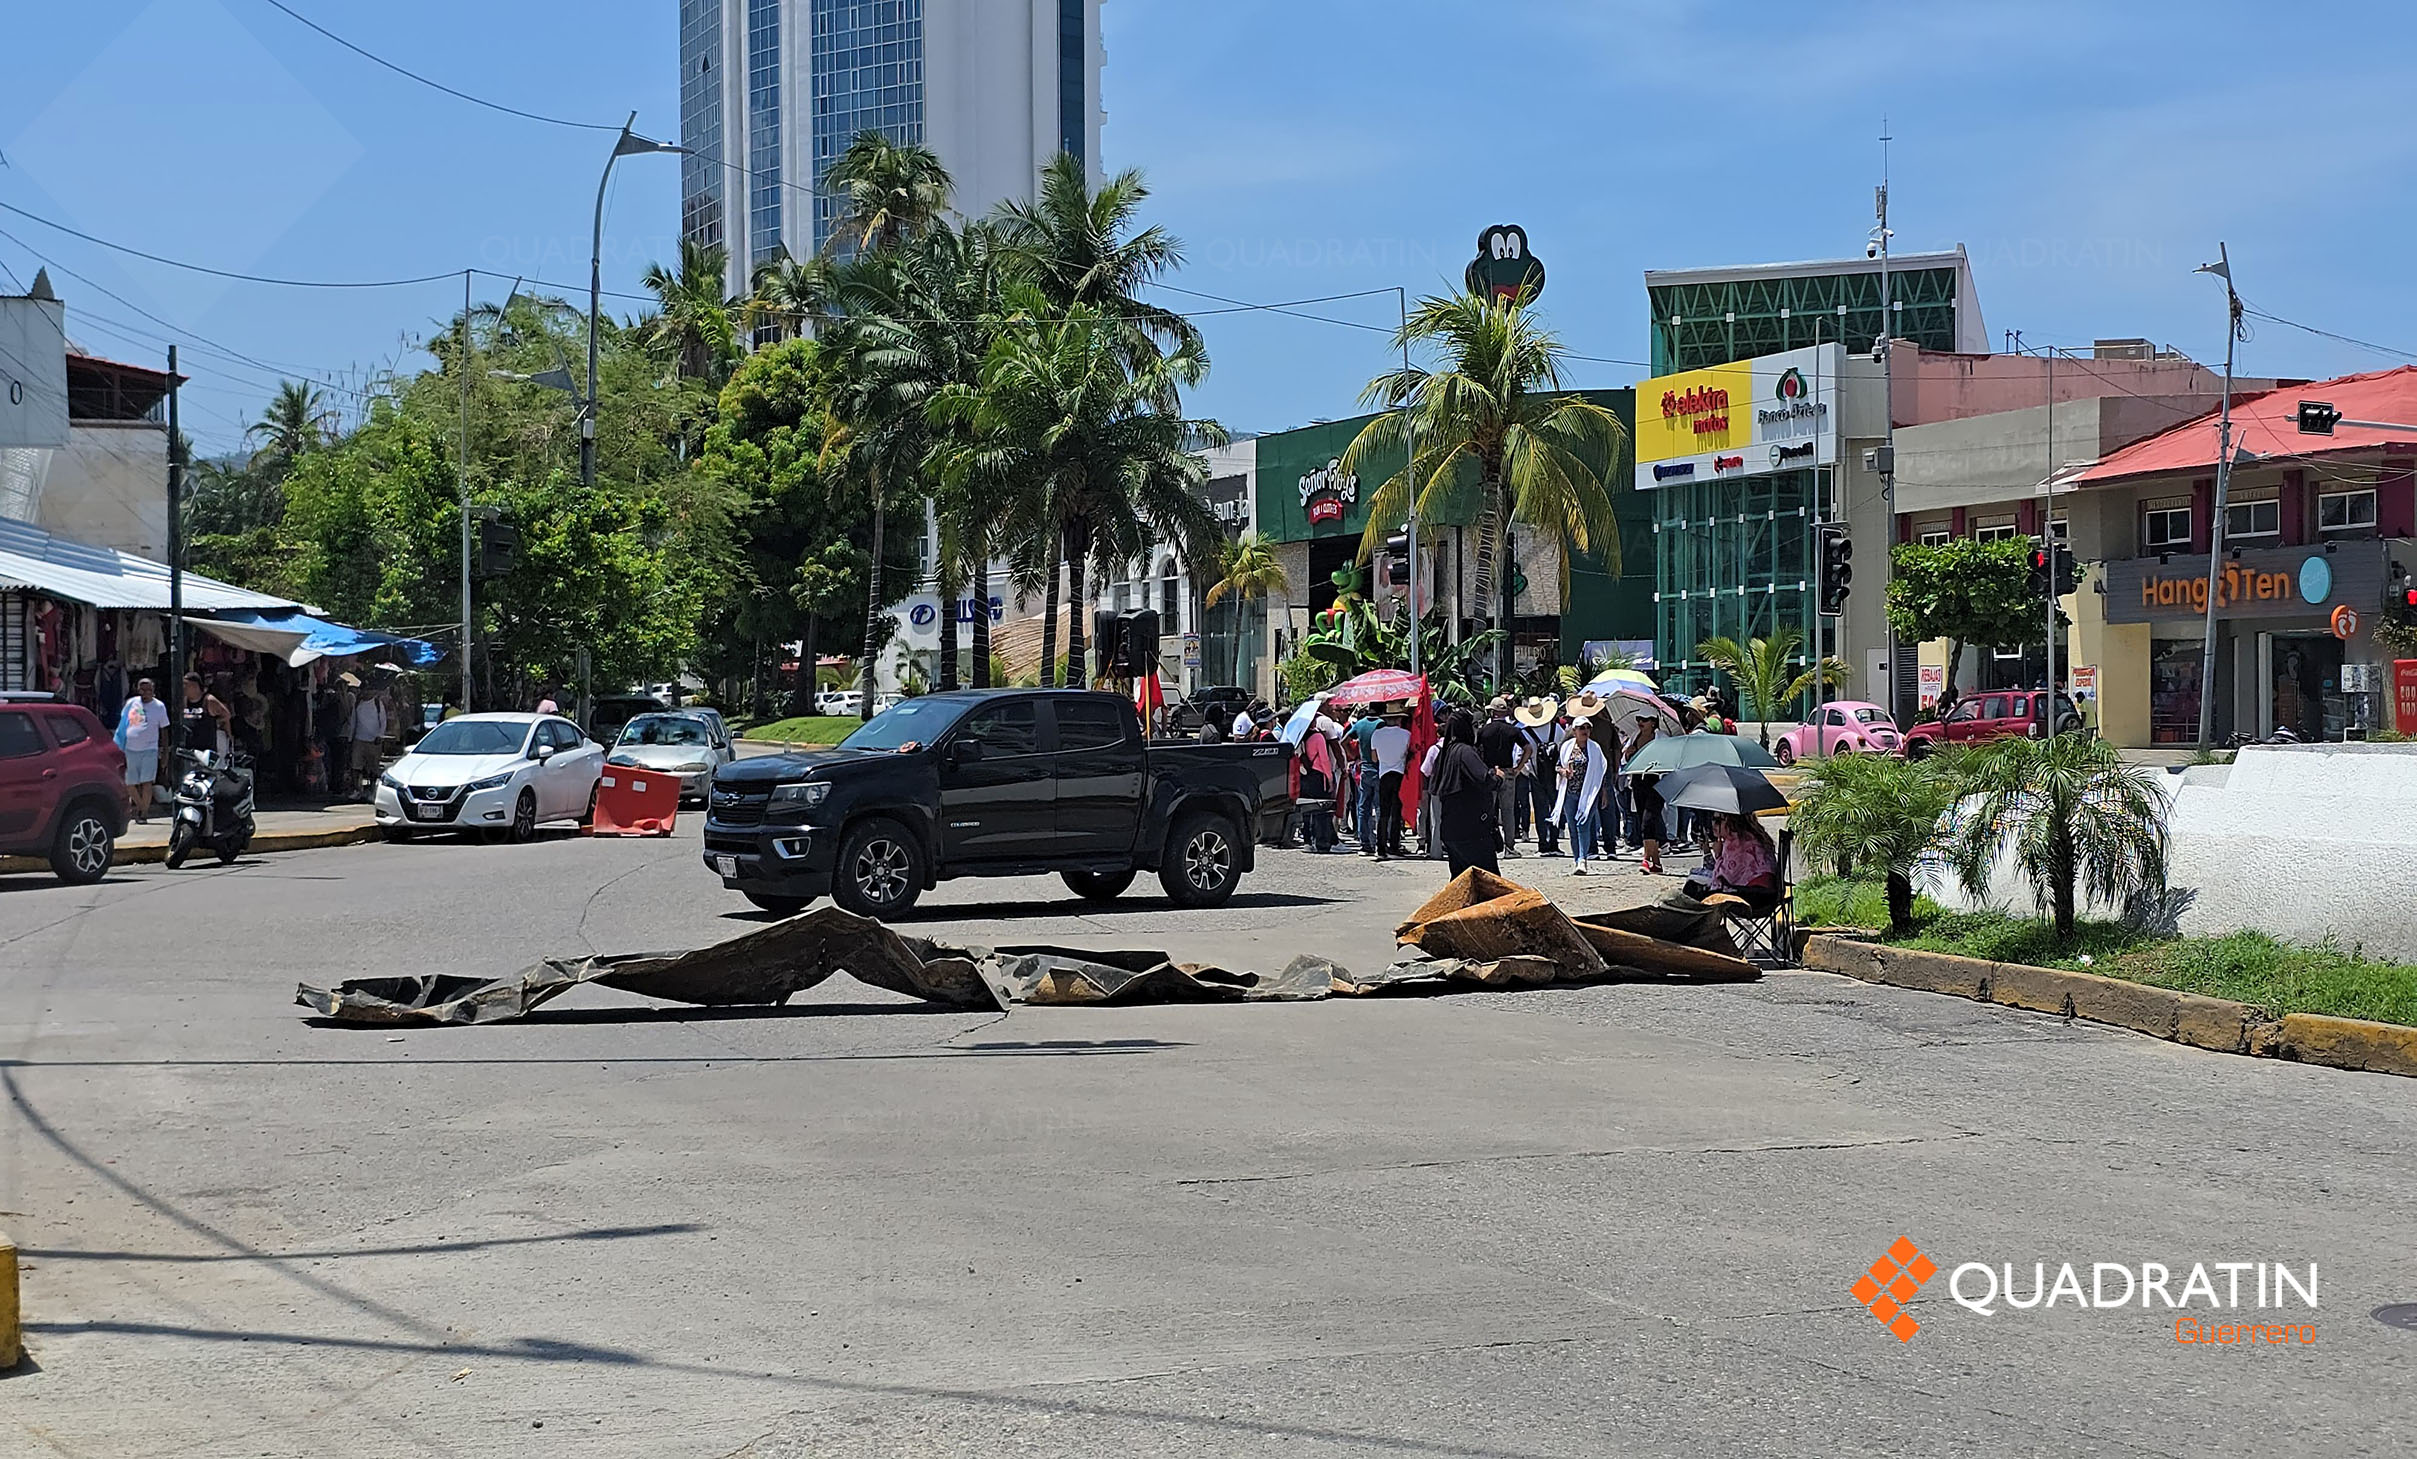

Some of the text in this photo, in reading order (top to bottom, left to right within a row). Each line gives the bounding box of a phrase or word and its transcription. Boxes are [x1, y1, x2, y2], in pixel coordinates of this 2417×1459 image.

[1677, 385, 1729, 415] elektra
[1693, 414, 1728, 434] motos
[1298, 467, 1328, 507] Señor
[2142, 575, 2209, 614] Hang
[2241, 567, 2290, 601] Ten
